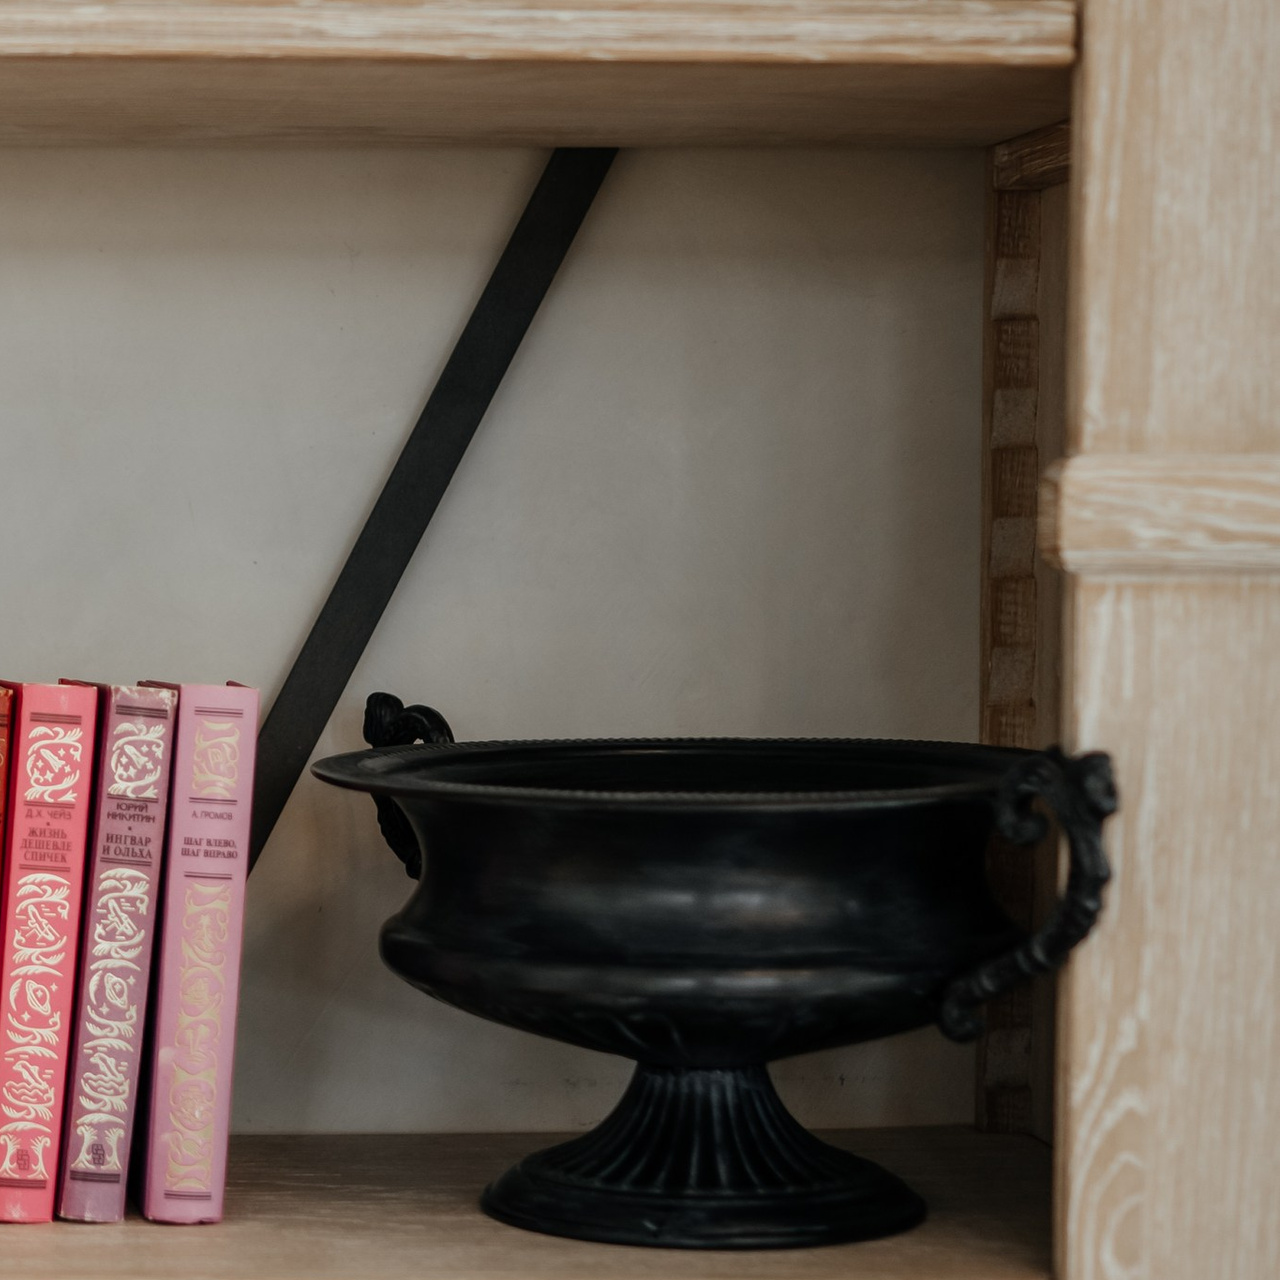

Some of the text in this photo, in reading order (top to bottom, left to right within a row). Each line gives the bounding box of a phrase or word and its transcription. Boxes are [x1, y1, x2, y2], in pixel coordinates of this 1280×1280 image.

[49, 806, 72, 820] ЧЕЙЗ
[116, 802, 149, 813] ЮРИЙ
[107, 812, 156, 824] НИКИТИН
[200, 810, 233, 820] ГРОМОВ
[28, 826, 67, 838] ЖИЗНЬ
[21, 839, 72, 852] ДЕШЕВЛЕ
[106, 833, 151, 846] ИНГВАР
[183, 836, 238, 849] ШАГ ВЛЕВО,
[24, 851, 67, 863] СПИЧЕК
[102, 845, 152, 859] И ОЛЬХА
[181, 848, 238, 860] ШАГ ВПРАВО
